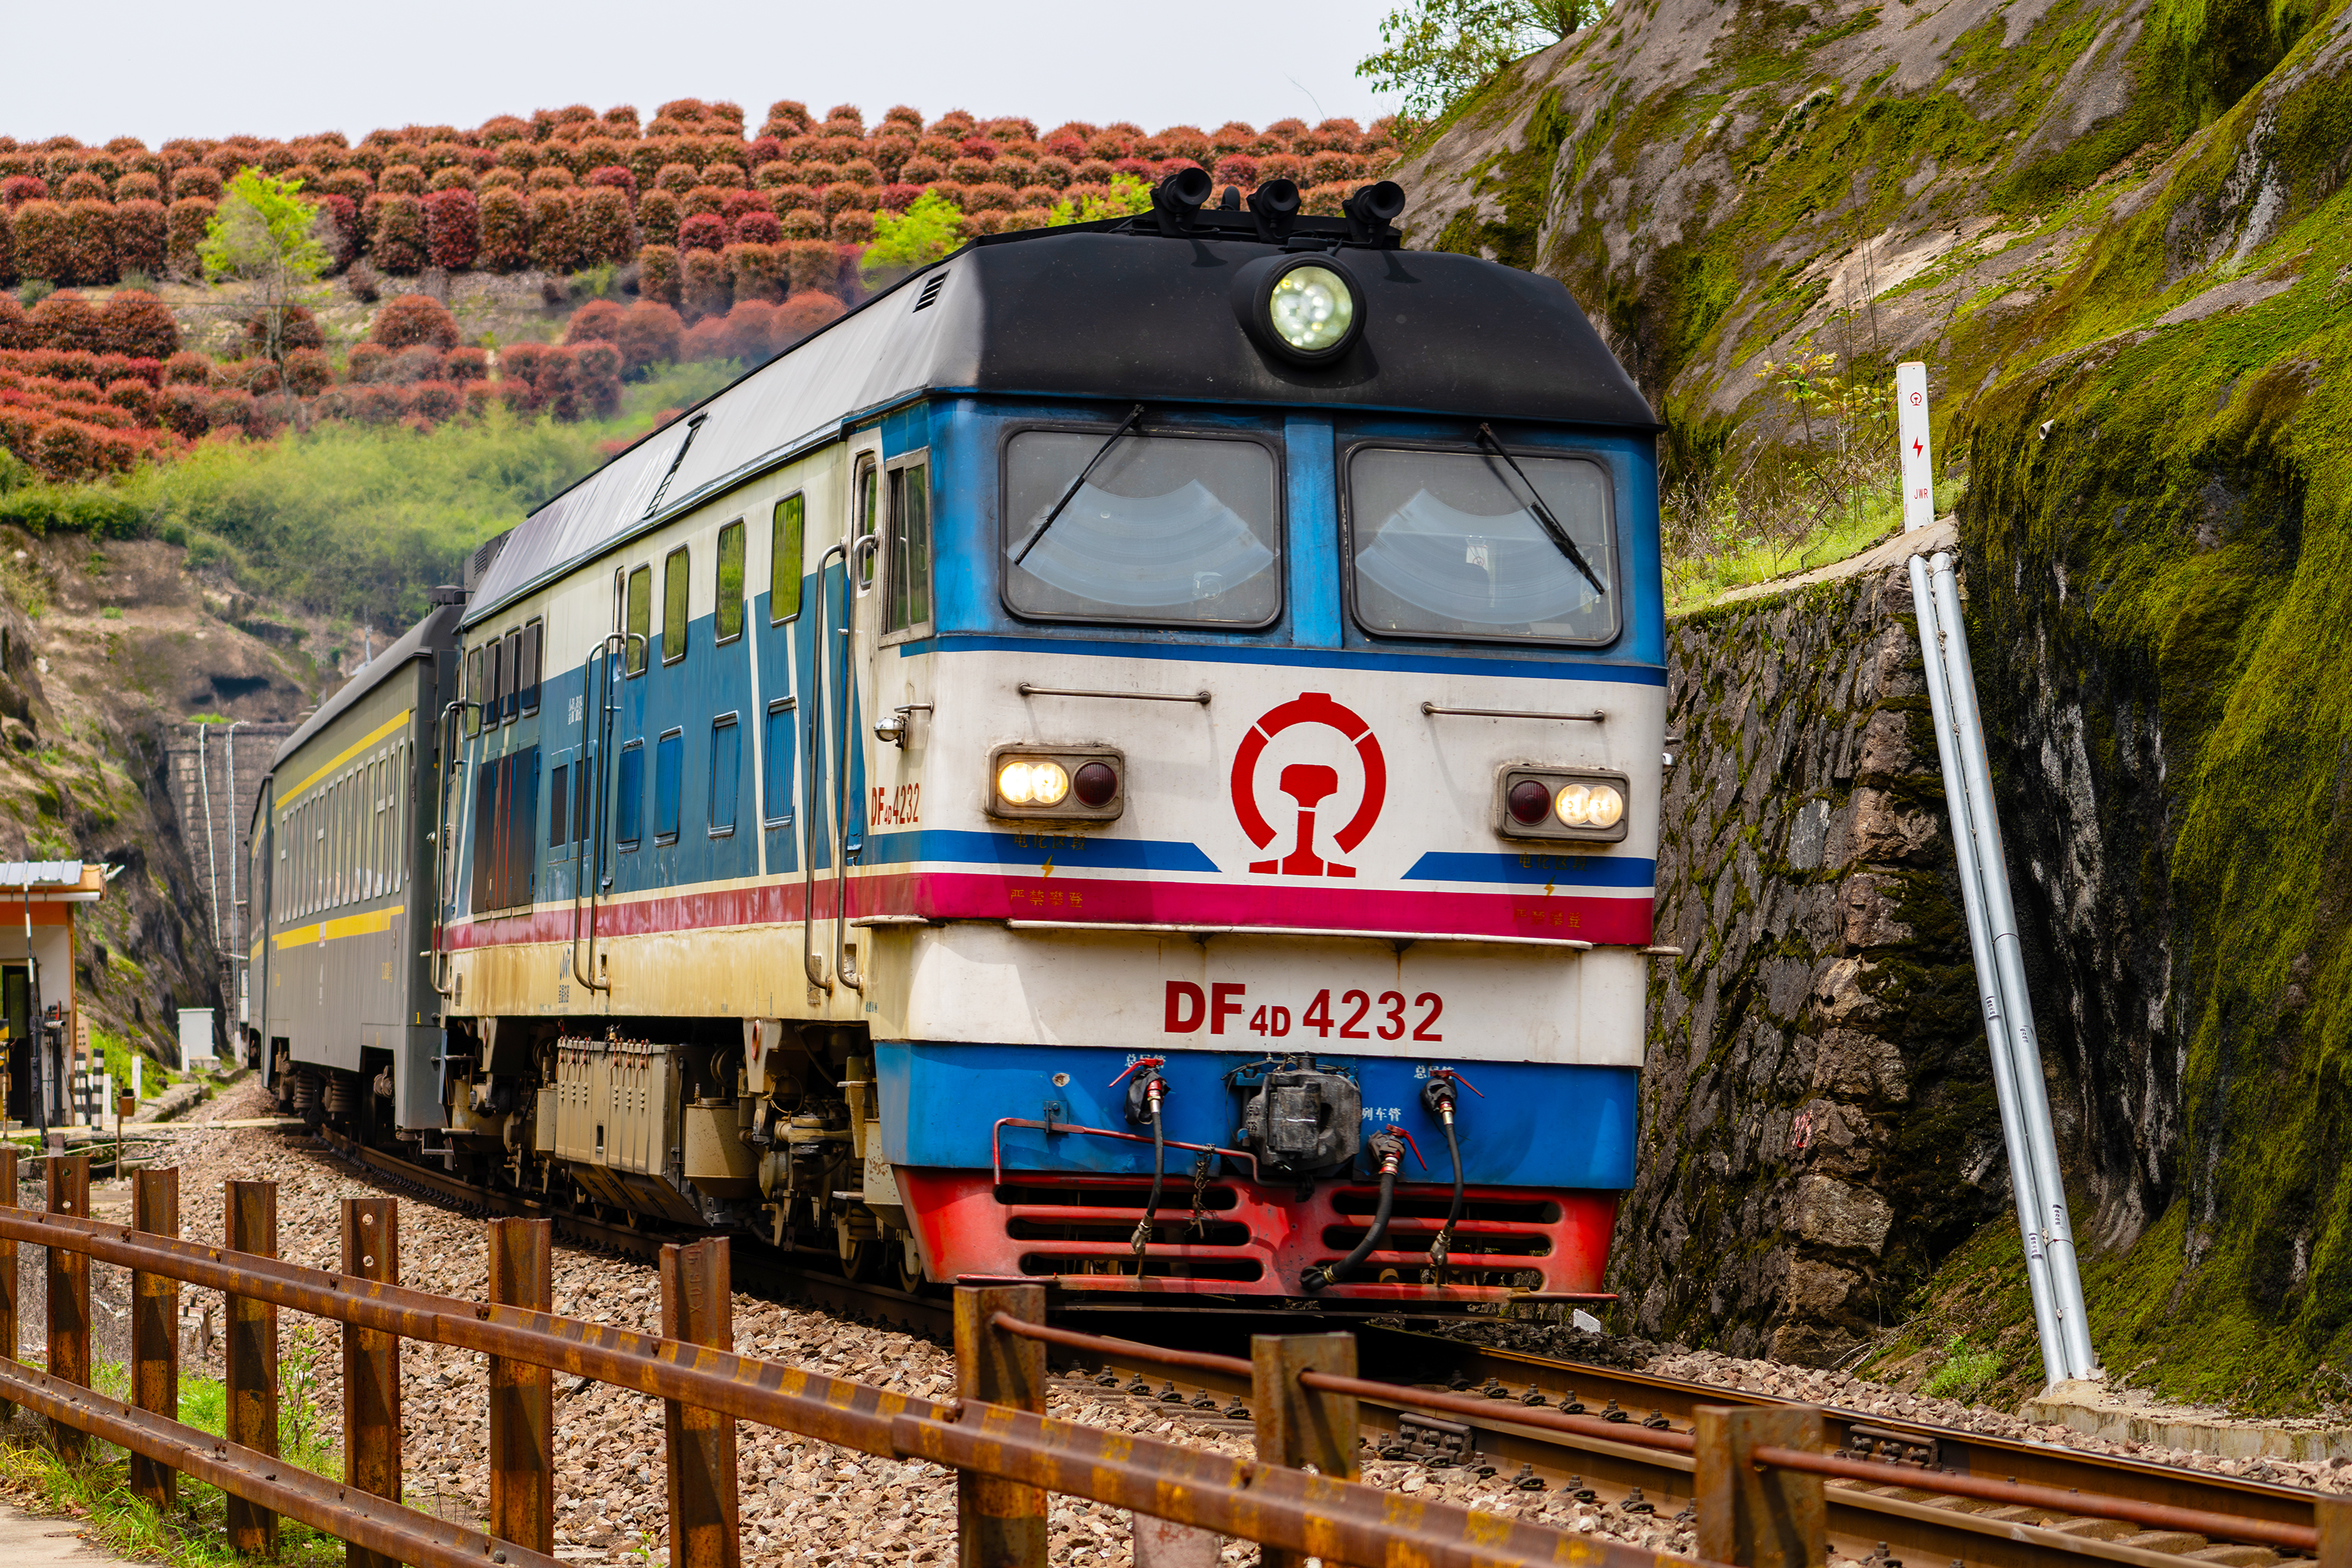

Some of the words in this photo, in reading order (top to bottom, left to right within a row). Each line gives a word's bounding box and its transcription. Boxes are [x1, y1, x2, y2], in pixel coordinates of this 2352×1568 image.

[1914, 488, 1929, 500] JWR
[1013, 830, 1087, 851] 电化区段
[1009, 889, 1083, 908] 严禁攀登
[416, 1011, 421, 1024] 1
[1302, 988, 1443, 1042] 4232
[1361, 1107, 1402, 1122] 列车管
